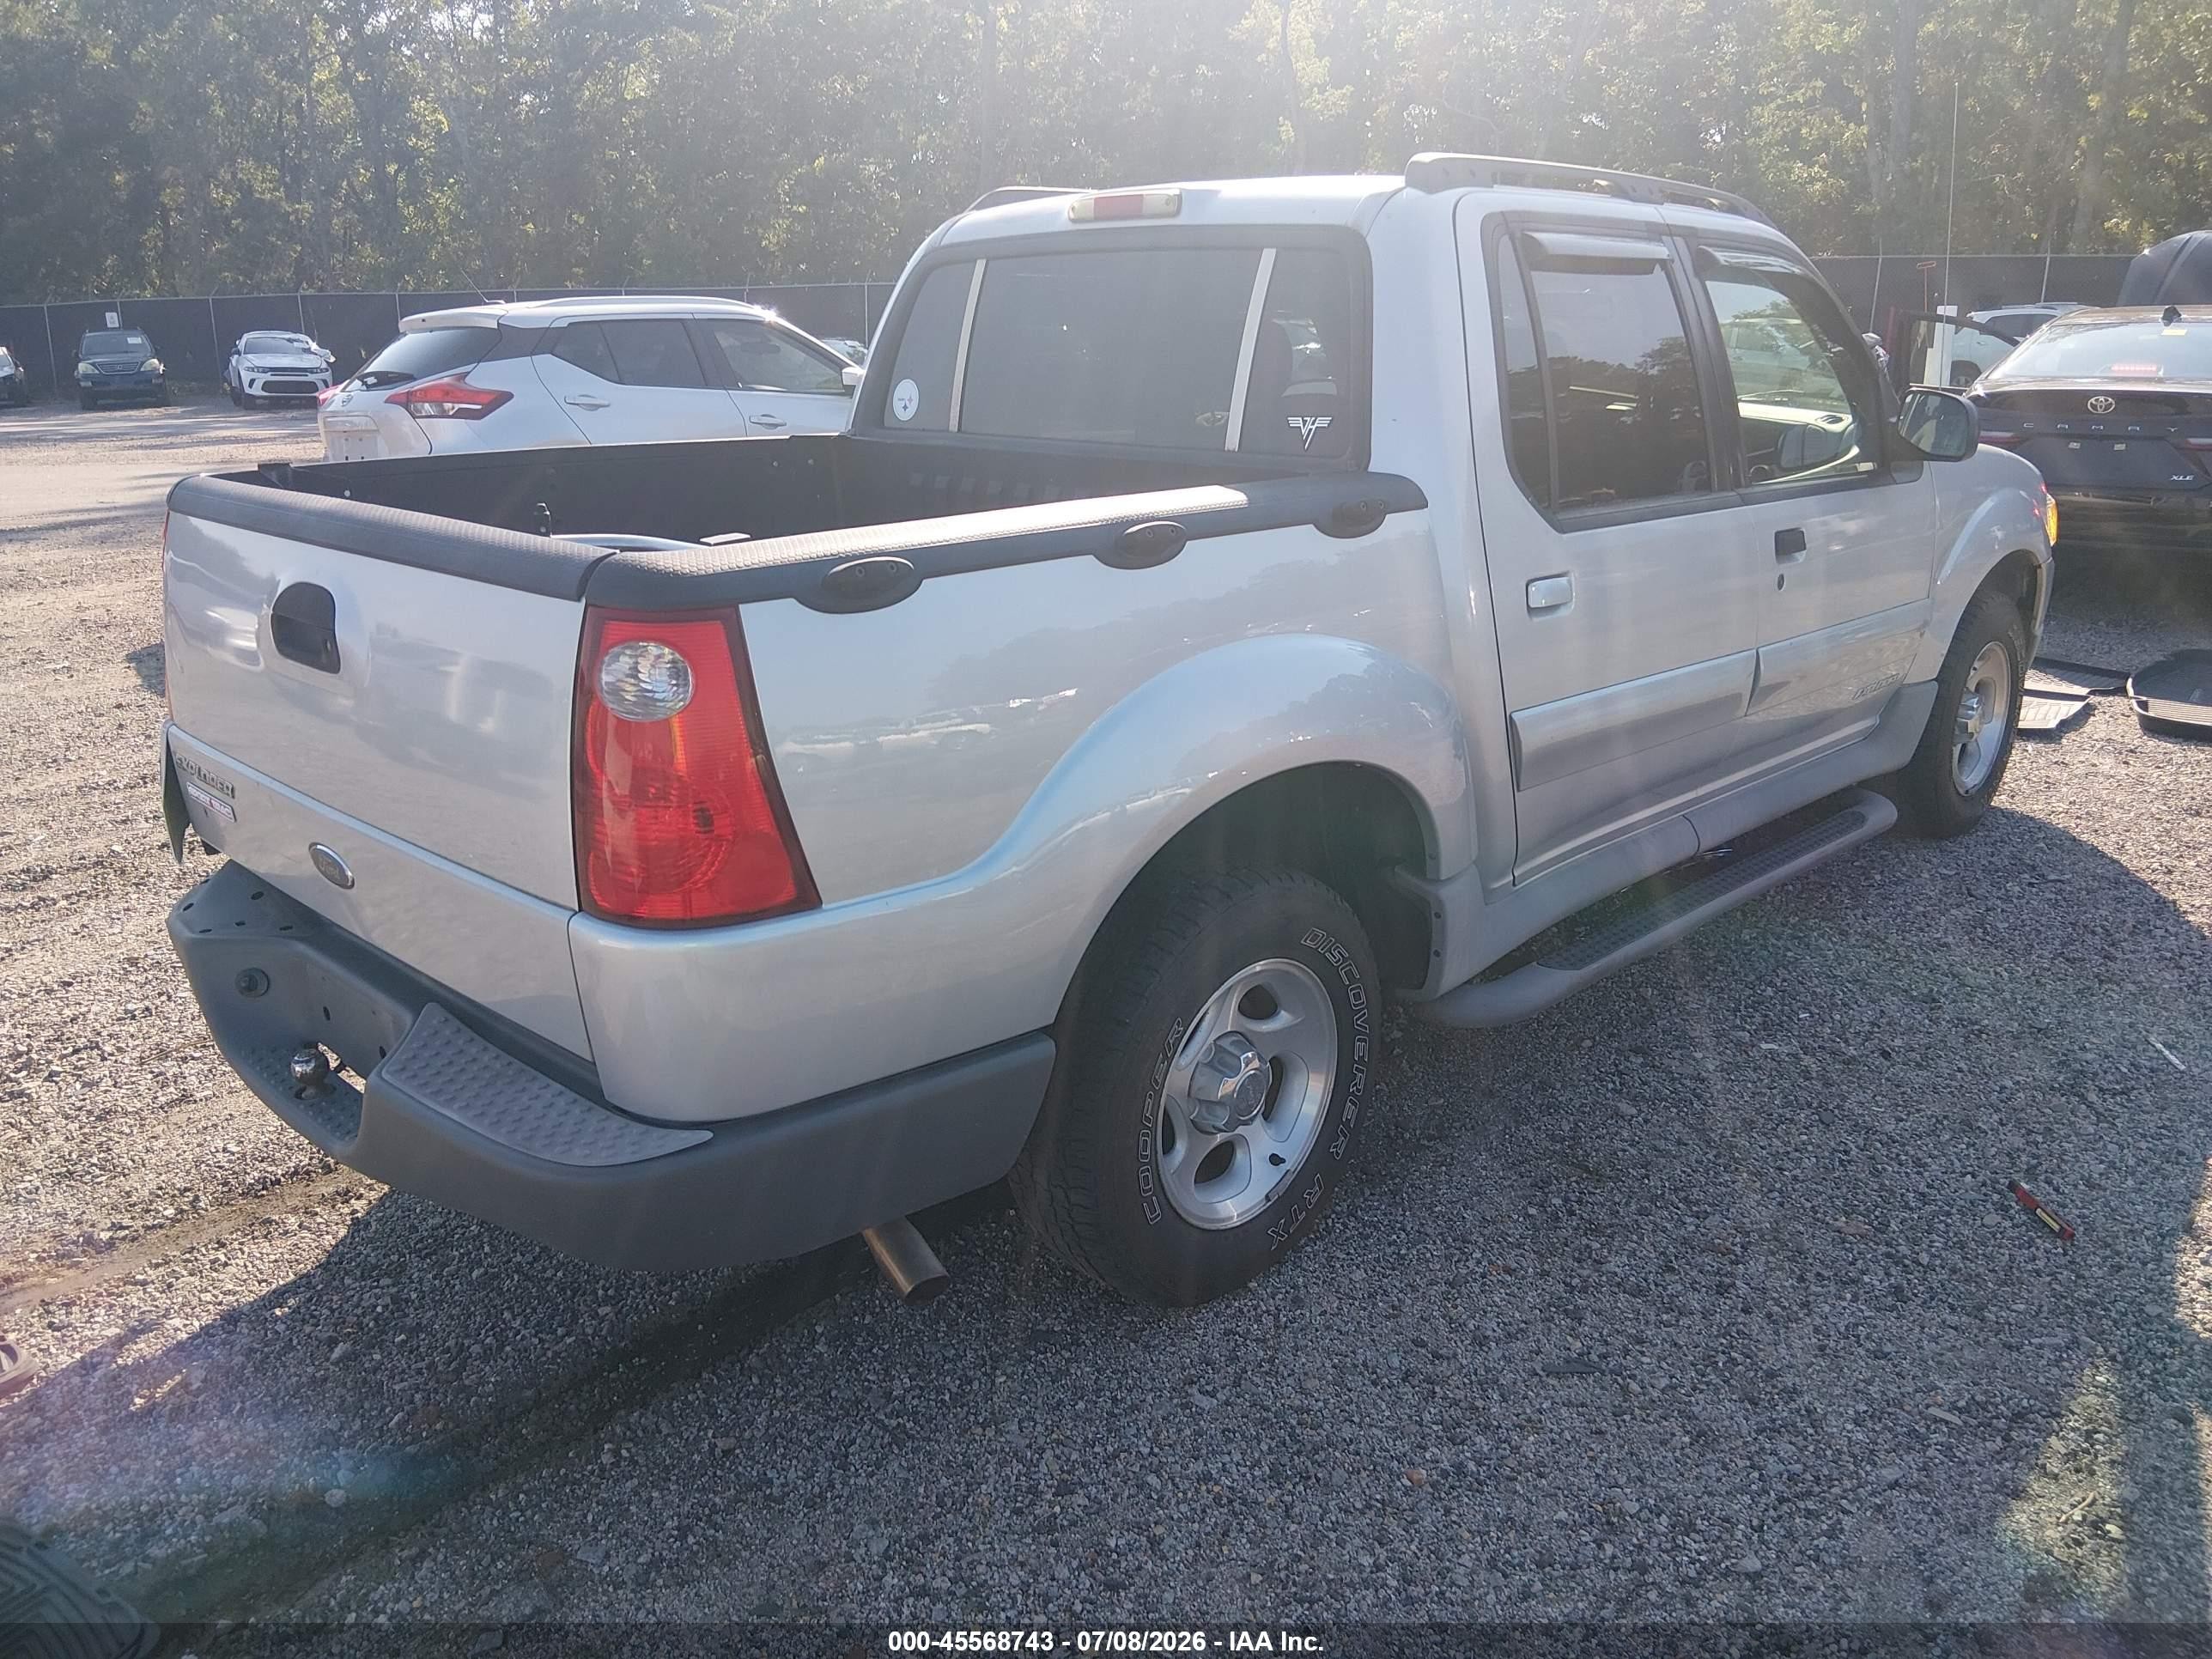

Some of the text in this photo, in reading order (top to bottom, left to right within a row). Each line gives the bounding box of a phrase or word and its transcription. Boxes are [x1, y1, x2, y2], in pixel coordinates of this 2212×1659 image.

[2023, 422, 2179, 433] CAMRY
[1138, 1016, 1183, 1225] COOPER
[1266, 927, 1370, 1251] DISCOVERER RTX
